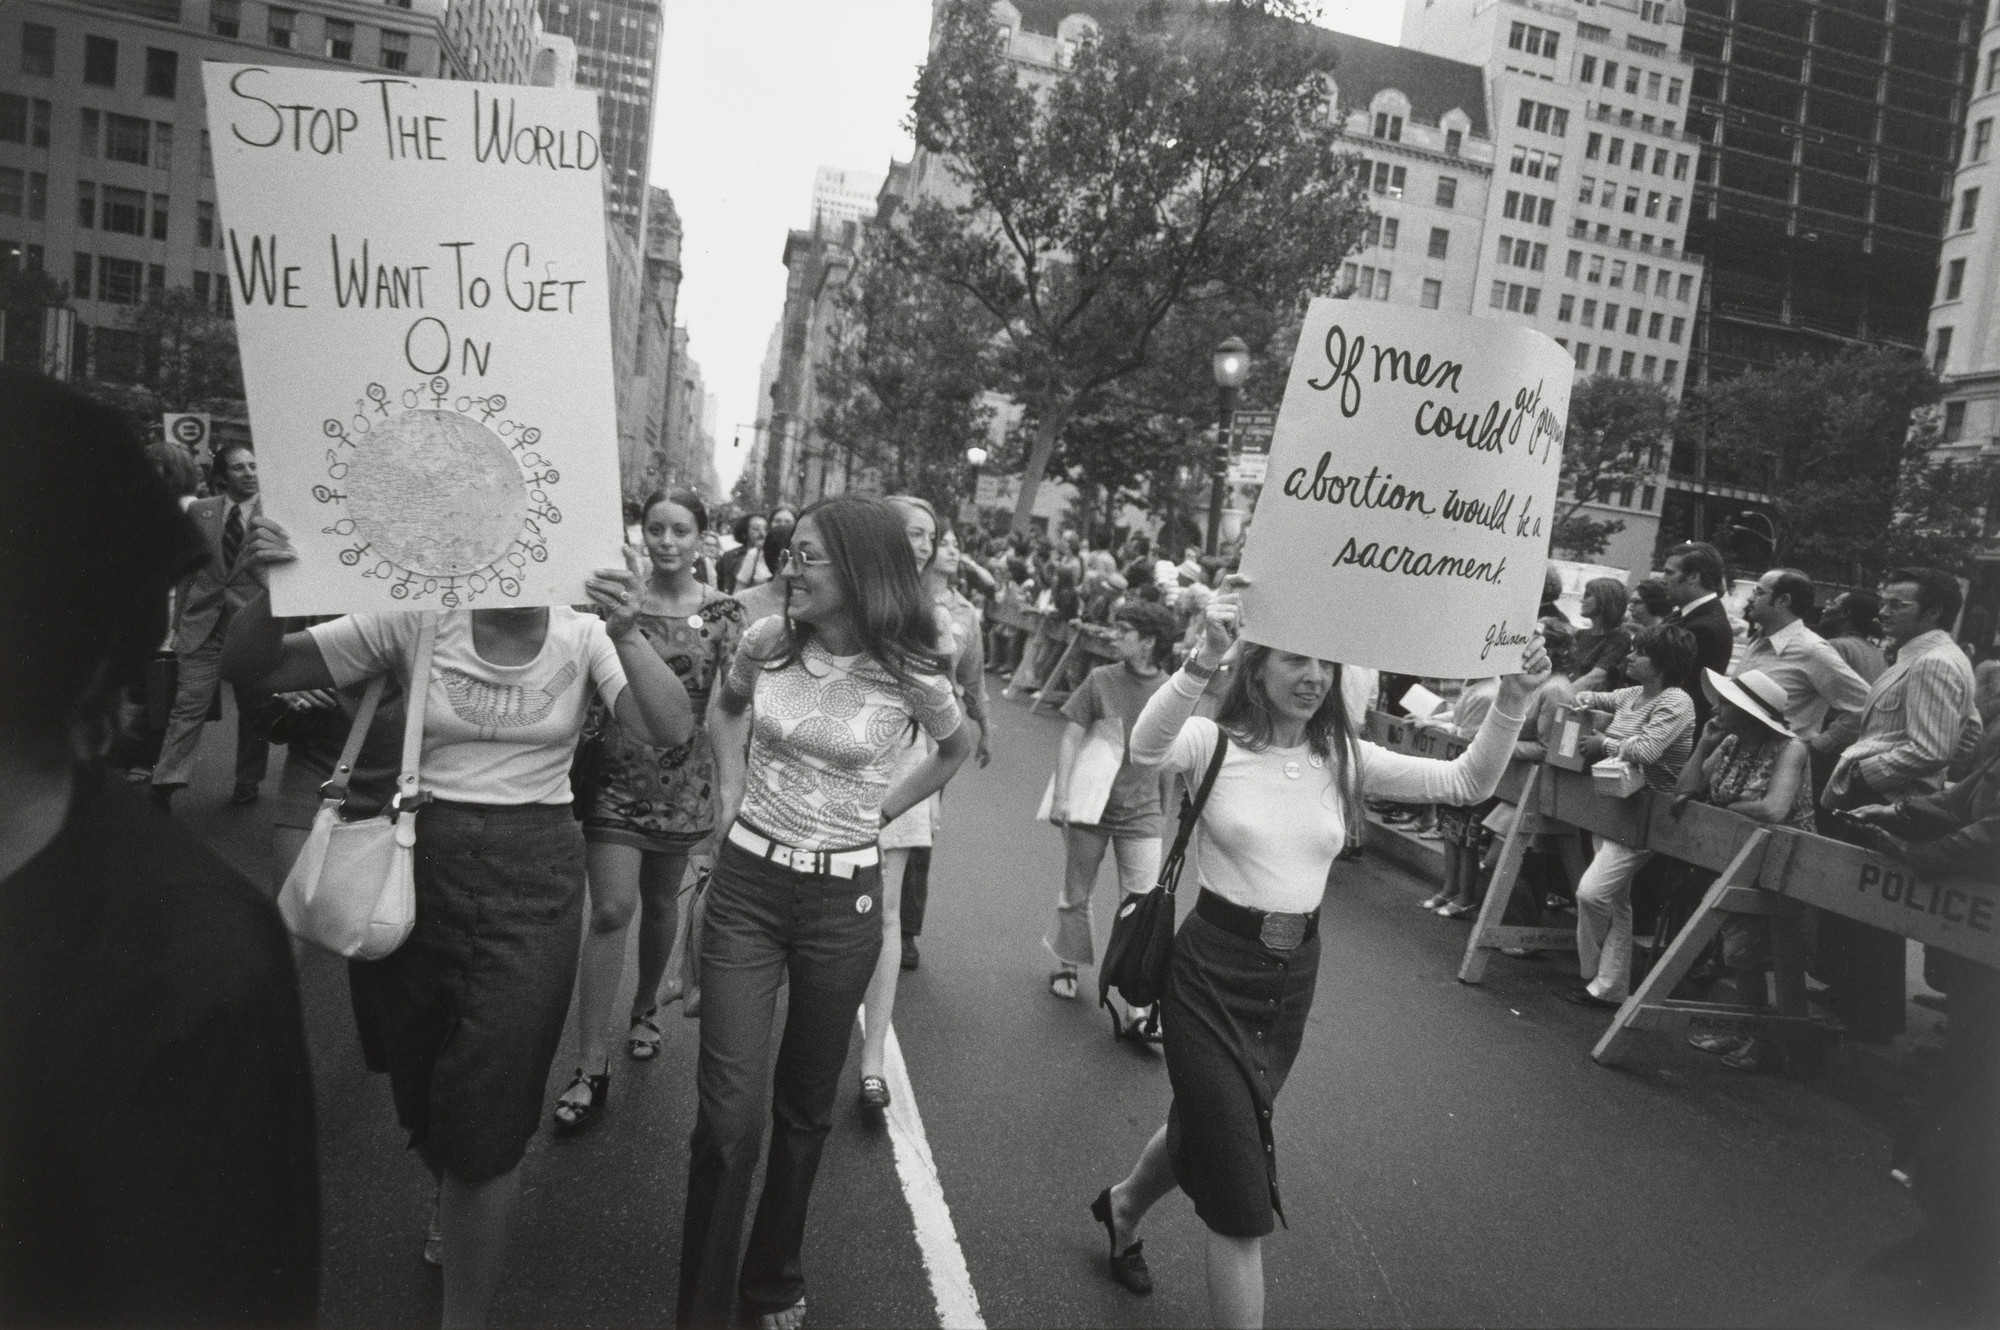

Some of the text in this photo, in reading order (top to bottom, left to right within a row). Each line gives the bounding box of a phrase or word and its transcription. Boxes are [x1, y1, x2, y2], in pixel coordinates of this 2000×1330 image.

[230, 68, 599, 171] STOP THE WORLD
[229, 228, 307, 308] WE
[331, 234, 430, 309] WANT
[504, 242, 586, 314] GET
[404, 317, 492, 377] ON
[1307, 324, 1463, 418] If men
[1414, 400, 1511, 454] could
[1508, 378, 1543, 445] get
[1283, 451, 1541, 538] abortion would be a
[1331, 537, 1507, 585] sacrament.
[1412, 731, 1437, 756] NOT
[1858, 862, 1994, 932] POLICE
[1689, 1015, 1734, 1030] POLICE
